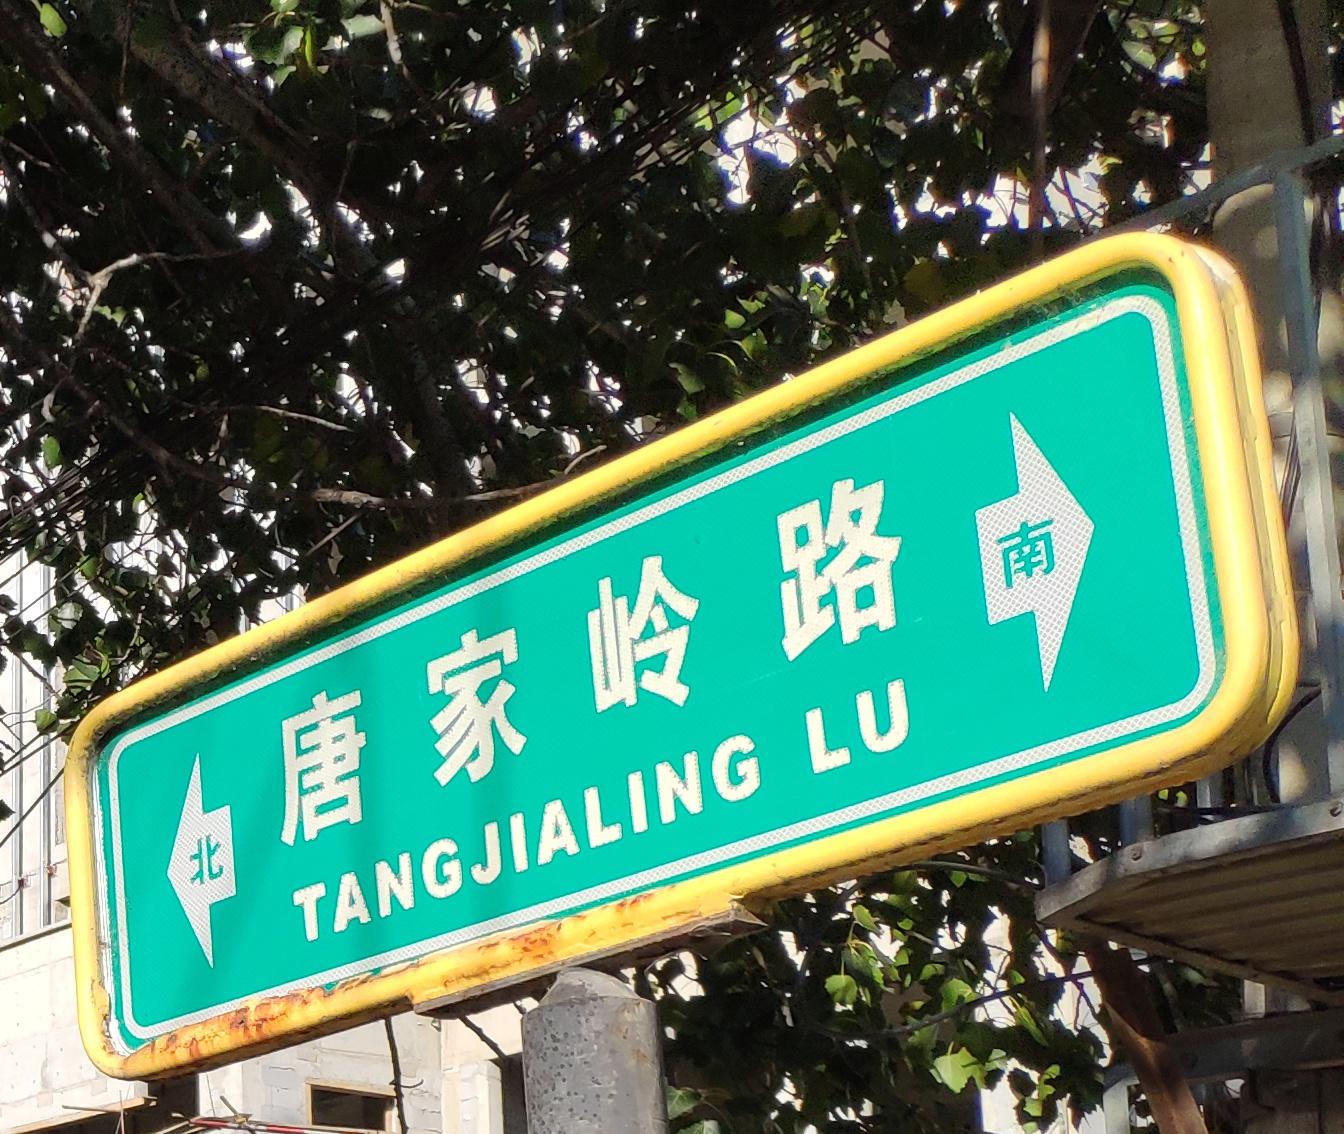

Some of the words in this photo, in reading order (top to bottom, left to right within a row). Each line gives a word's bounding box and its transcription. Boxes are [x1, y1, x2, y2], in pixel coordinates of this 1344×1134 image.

[997, 519, 1054, 589] 南
[280, 478, 902, 846] 唐家岭路
[190, 835, 223, 884] 北
[294, 736, 761, 941] TANGJIALING
[807, 680, 909, 775] LU
